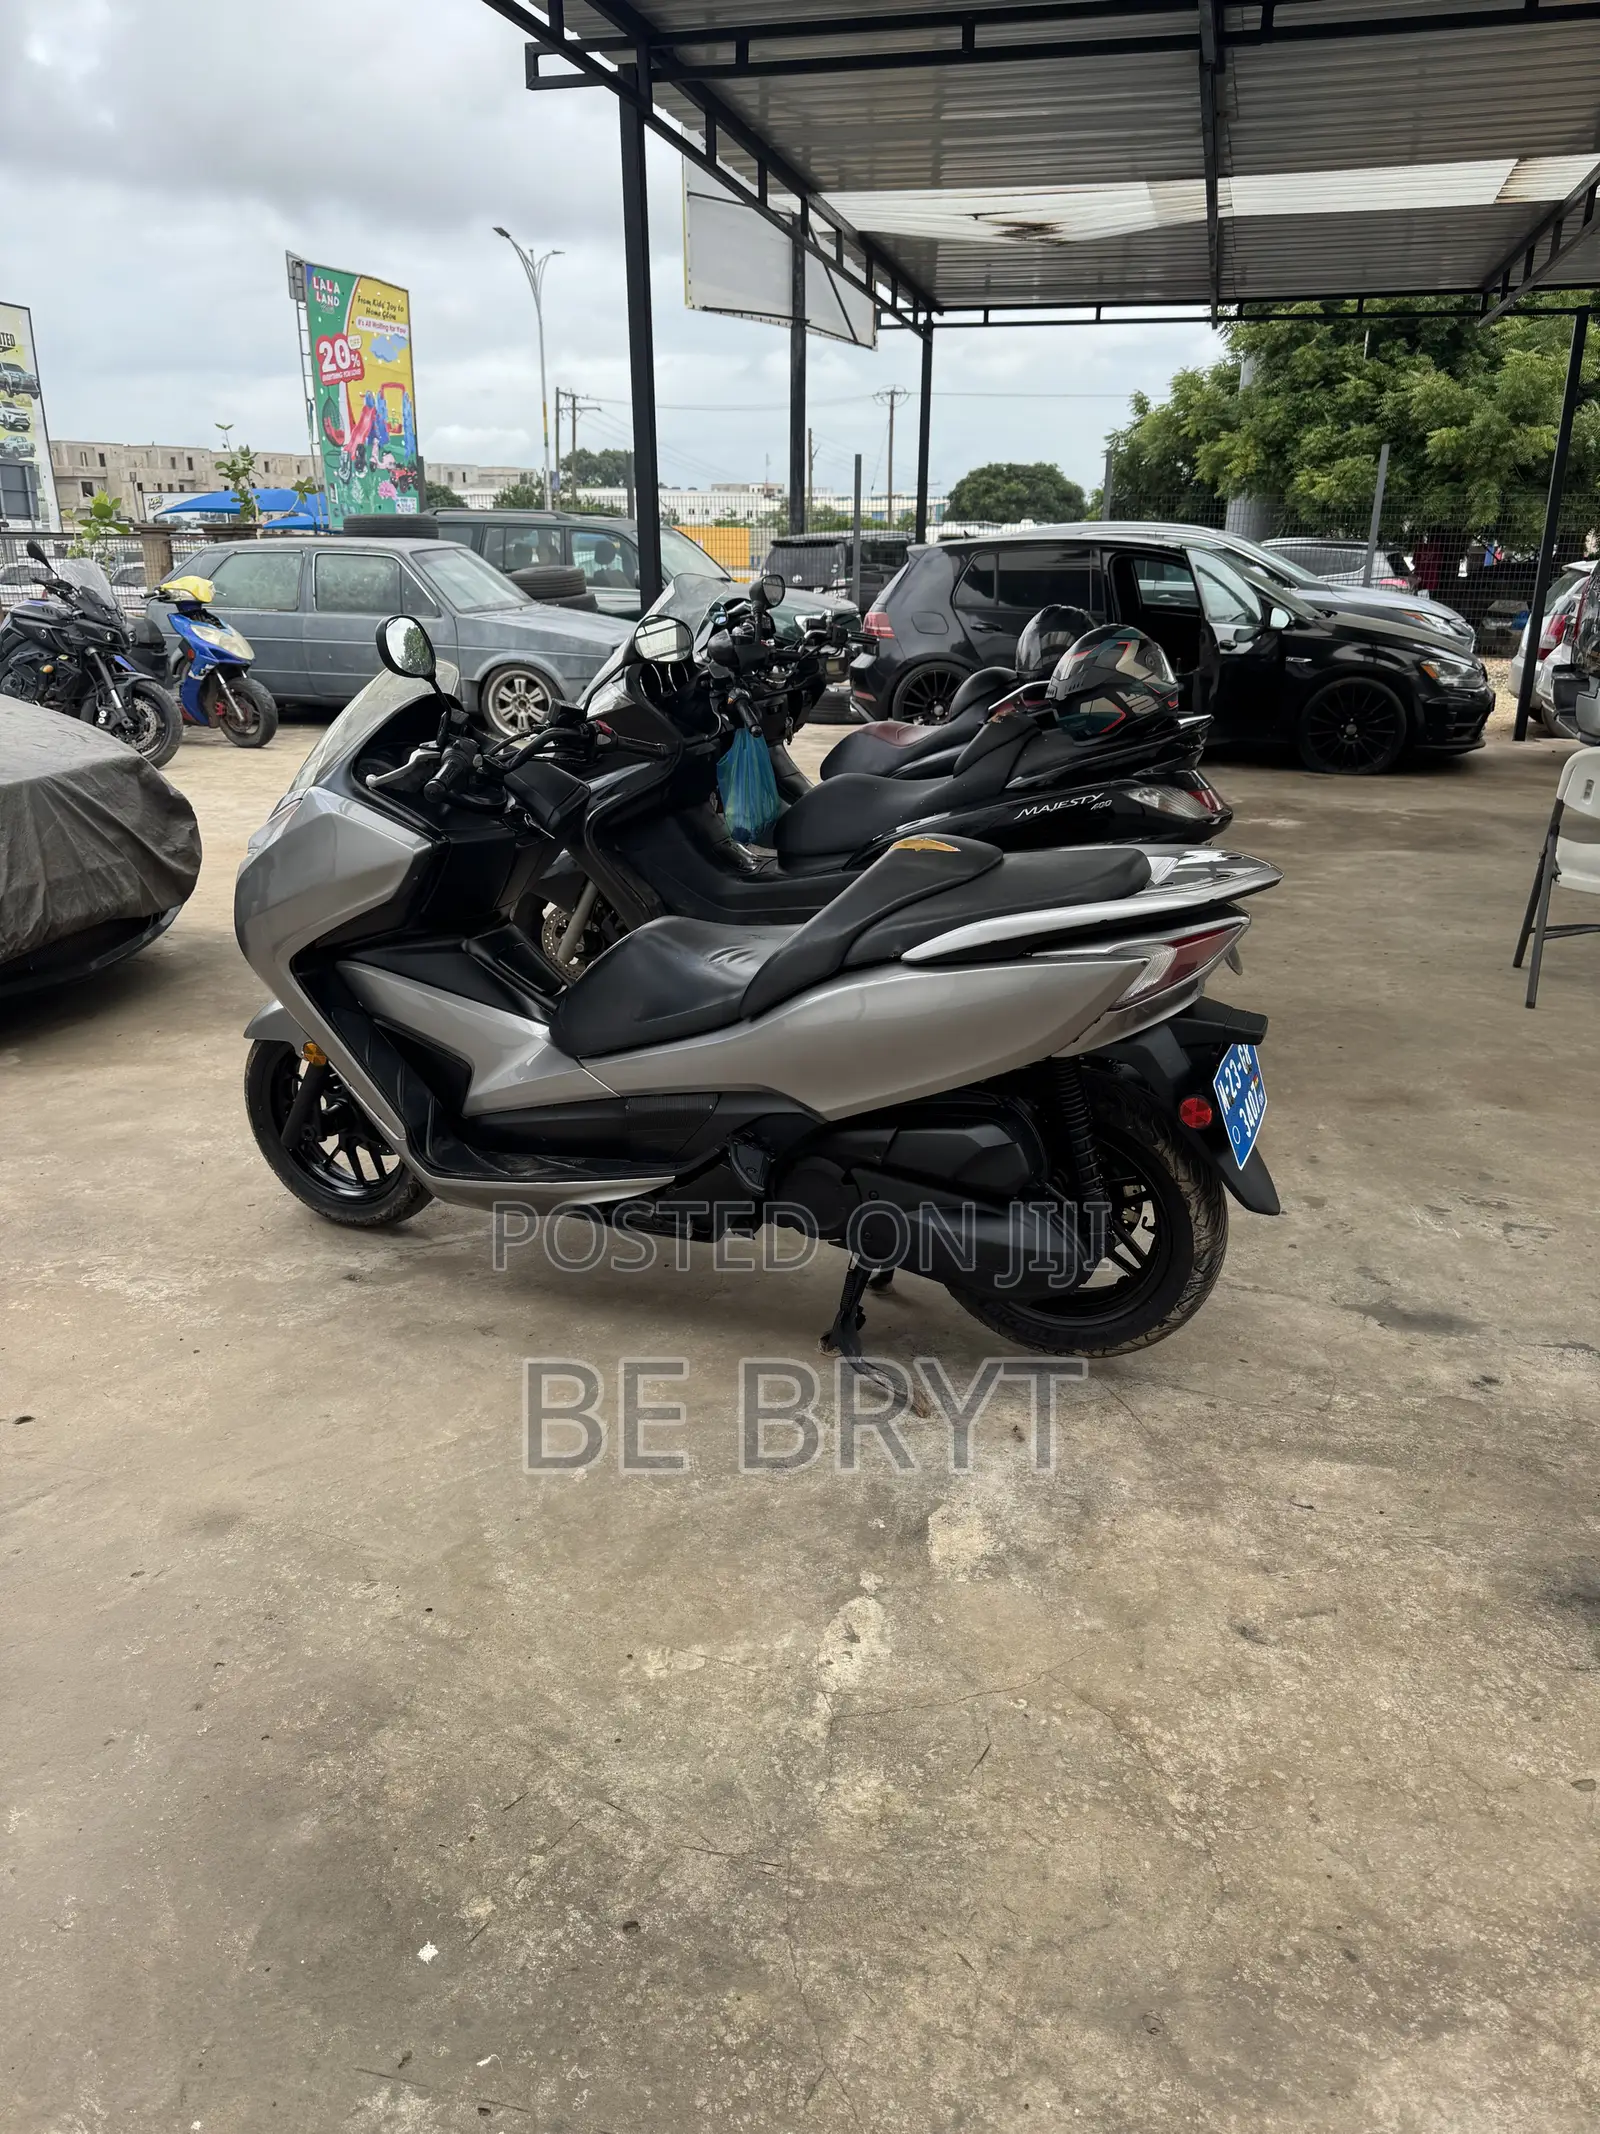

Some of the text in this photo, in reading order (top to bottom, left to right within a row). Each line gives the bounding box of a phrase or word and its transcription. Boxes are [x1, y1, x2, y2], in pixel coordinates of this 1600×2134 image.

[316, 290, 340, 307] LAND
[1014, 792, 1113, 820] MAJESTY 400
